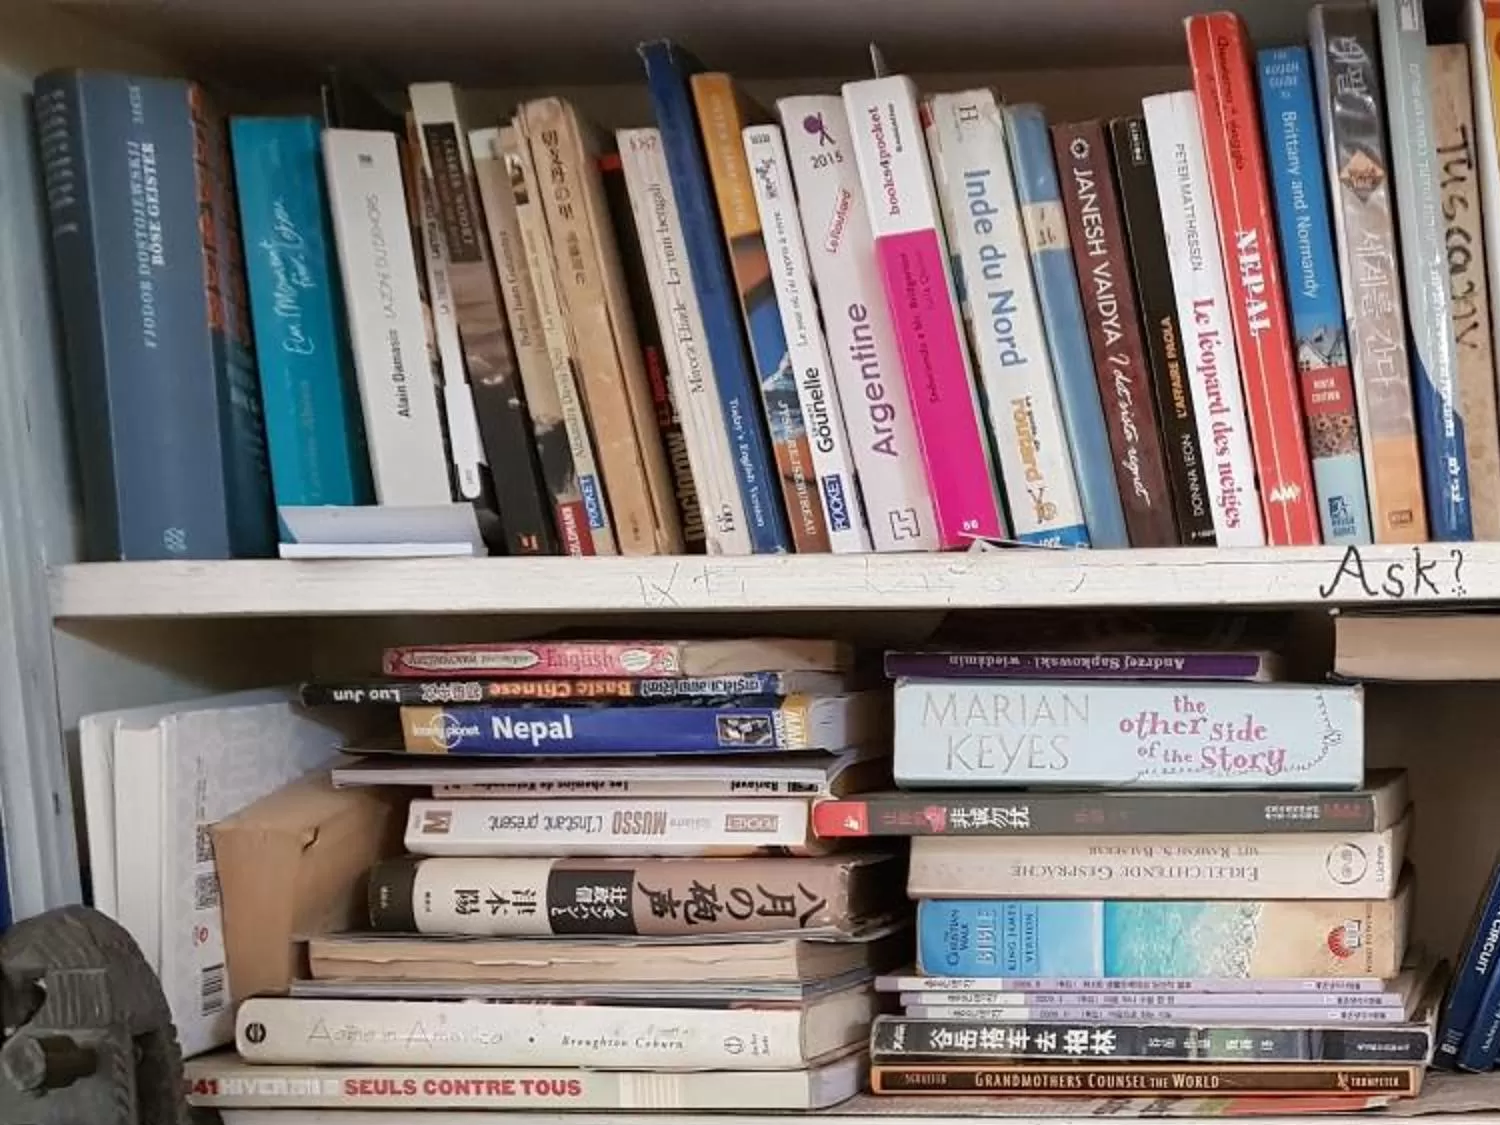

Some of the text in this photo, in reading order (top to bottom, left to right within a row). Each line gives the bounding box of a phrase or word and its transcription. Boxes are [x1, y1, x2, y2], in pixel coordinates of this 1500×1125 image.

[810, 151, 844, 170] 2015
[1281, 110, 1318, 299] Brittany and Normandy
[964, 168, 1028, 368] Inde du Nord
[1073, 168, 1124, 347] JANESH VAIDYA
[1234, 227, 1271, 337] NEPAL
[848, 301, 899, 458] Argentine
[803, 366, 834, 454] Gounelle
[1192, 297, 1244, 530] Le léopard des neiges
[822, 474, 850, 532] POCKET
[1034, 656, 1186, 673] Andrzej Sapkowski
[333, 688, 365, 703] Jun
[369, 688, 400, 701] Luo
[488, 681, 573, 698] Chinese
[577, 680, 632, 698] Basic
[1173, 695, 1207, 714] the
[921, 692, 1091, 729] MARIAN
[1118, 711, 1268, 743] other side
[491, 713, 574, 747] Nepal
[945, 735, 1072, 773] KEYES
[1137, 742, 1288, 776] of the Story
[488, 811, 669, 835] MUSSO présent
[950, 805, 1032, 830] 非诚勿扰
[454, 886, 540, 916] 津本陽
[637, 880, 829, 930] 八月の砲声
[344, 1079, 582, 1097] SEULS CONTRE TOUS
[973, 1071, 1221, 1091] GRANDMOTHERS COUNSEL THE WORLD
